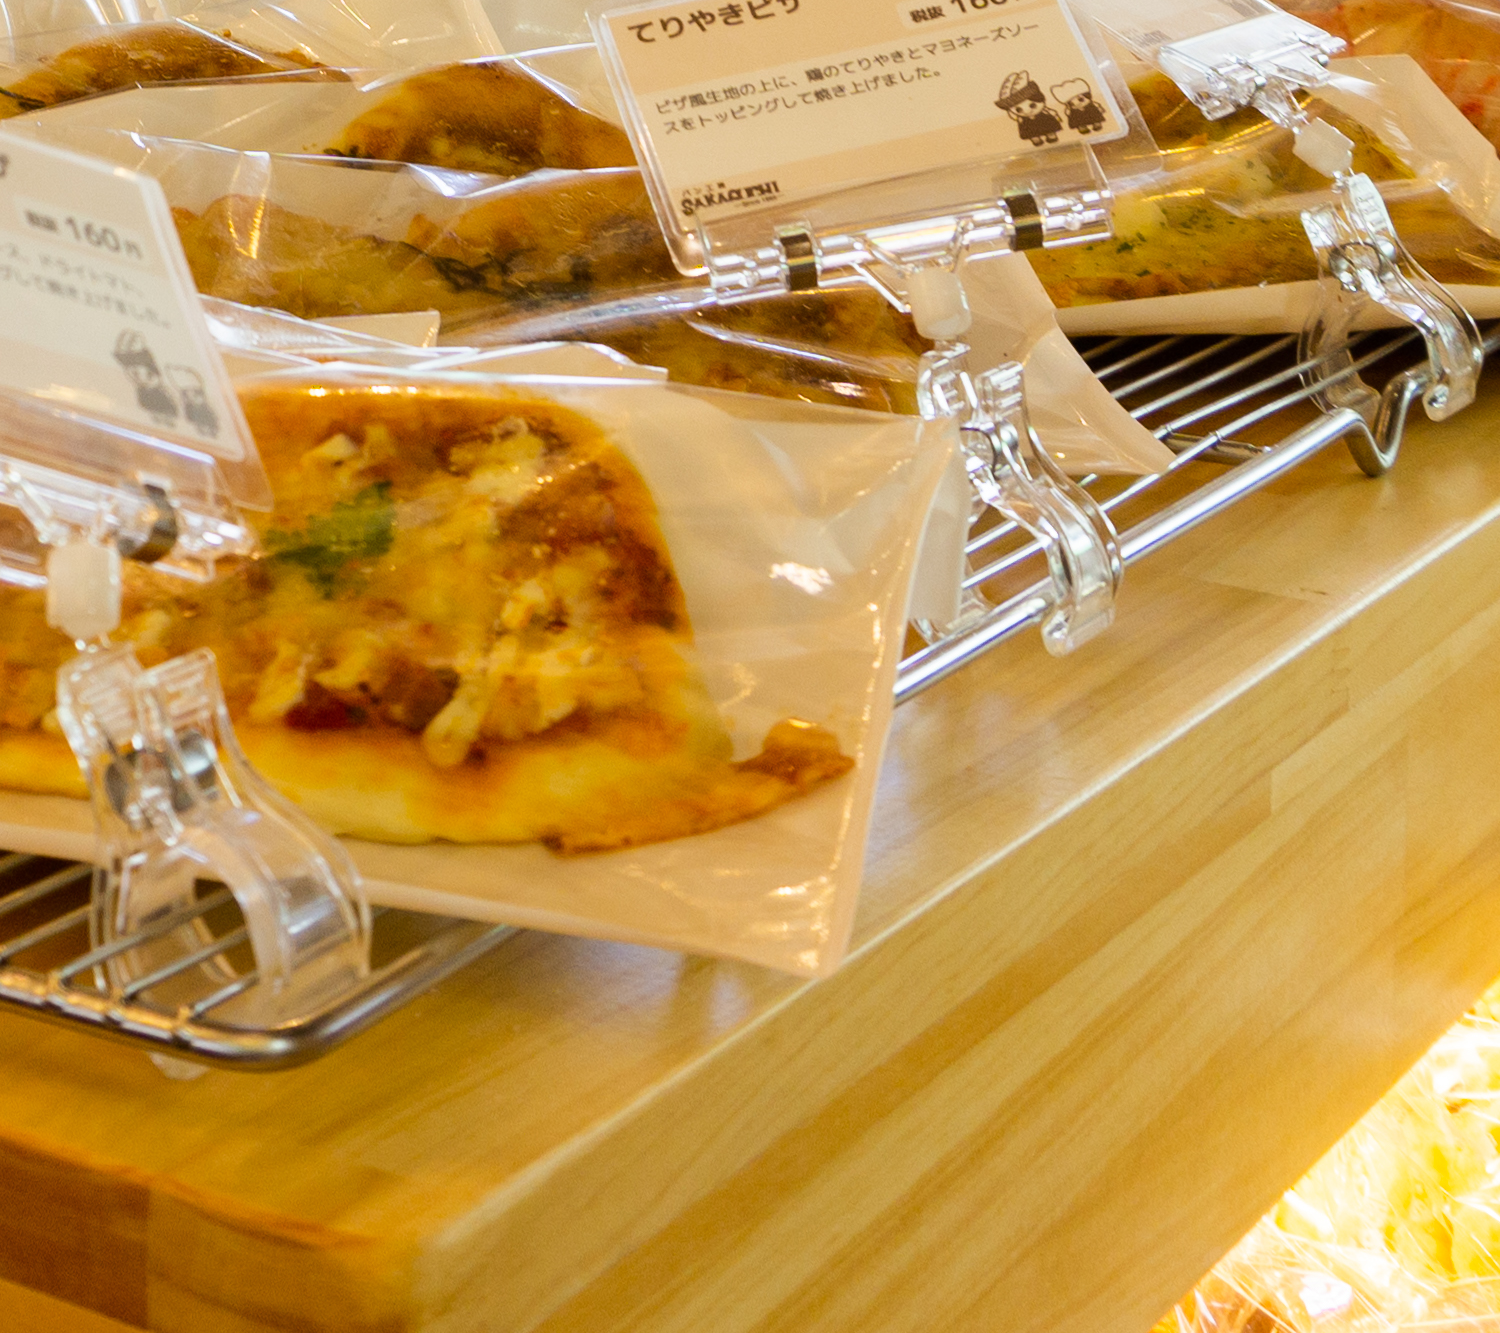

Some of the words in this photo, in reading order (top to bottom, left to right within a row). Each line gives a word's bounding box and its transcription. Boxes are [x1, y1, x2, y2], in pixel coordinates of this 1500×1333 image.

[909, 3, 946, 25] 税抜
[663, 65, 944, 135] スをトッピングして焼き上げました。
